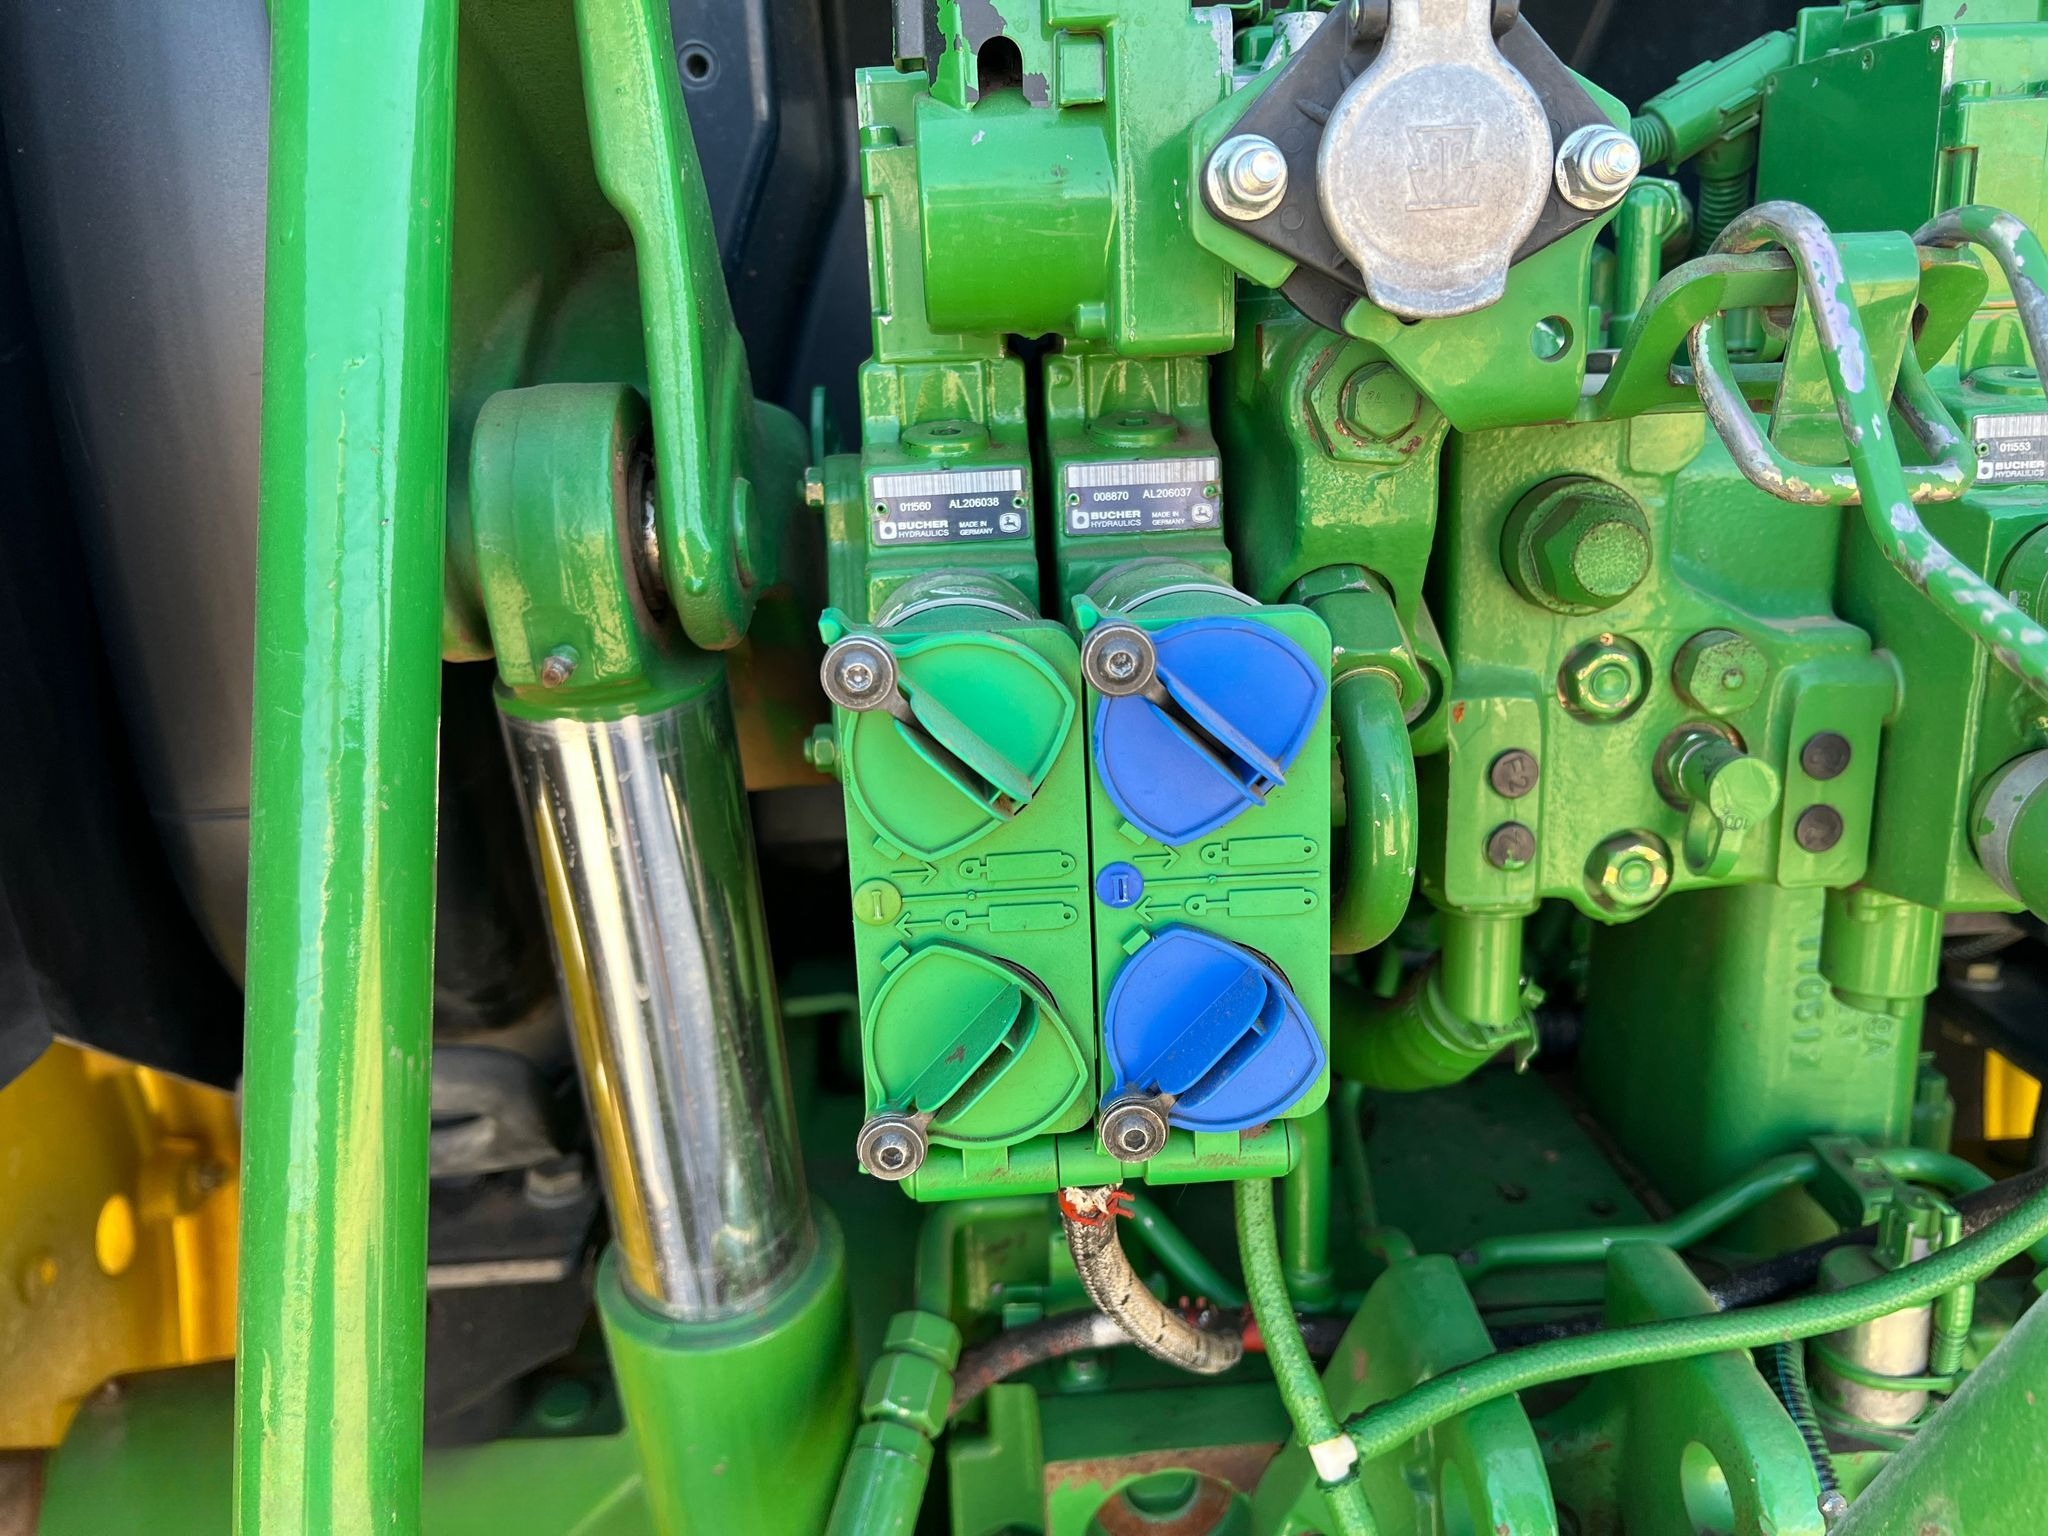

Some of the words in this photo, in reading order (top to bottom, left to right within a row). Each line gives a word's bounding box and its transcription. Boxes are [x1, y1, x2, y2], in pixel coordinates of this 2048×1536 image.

[1995, 460, 2045, 470] BUCHER
[1994, 469, 2045, 478] HYDRAULICS
[1093, 491, 1129, 502] 008870
[1142, 488, 1192, 499] AL206037
[900, 501, 932, 512] 011560
[949, 497, 1000, 509] AL206038
[1090, 510, 1141, 520] BUCHER
[1151, 511, 1171, 519] MADE
[1172, 510, 1180, 518] IN
[897, 520, 949, 530] BUCHER
[959, 520, 979, 529] MADE
[980, 520, 988, 528] IN
[1090, 519, 1142, 528] HYDRAULICS
[1151, 518, 1186, 526] GERMANY
[898, 529, 950, 538] HYDRAULICS
[960, 528, 994, 536] GERMANY
